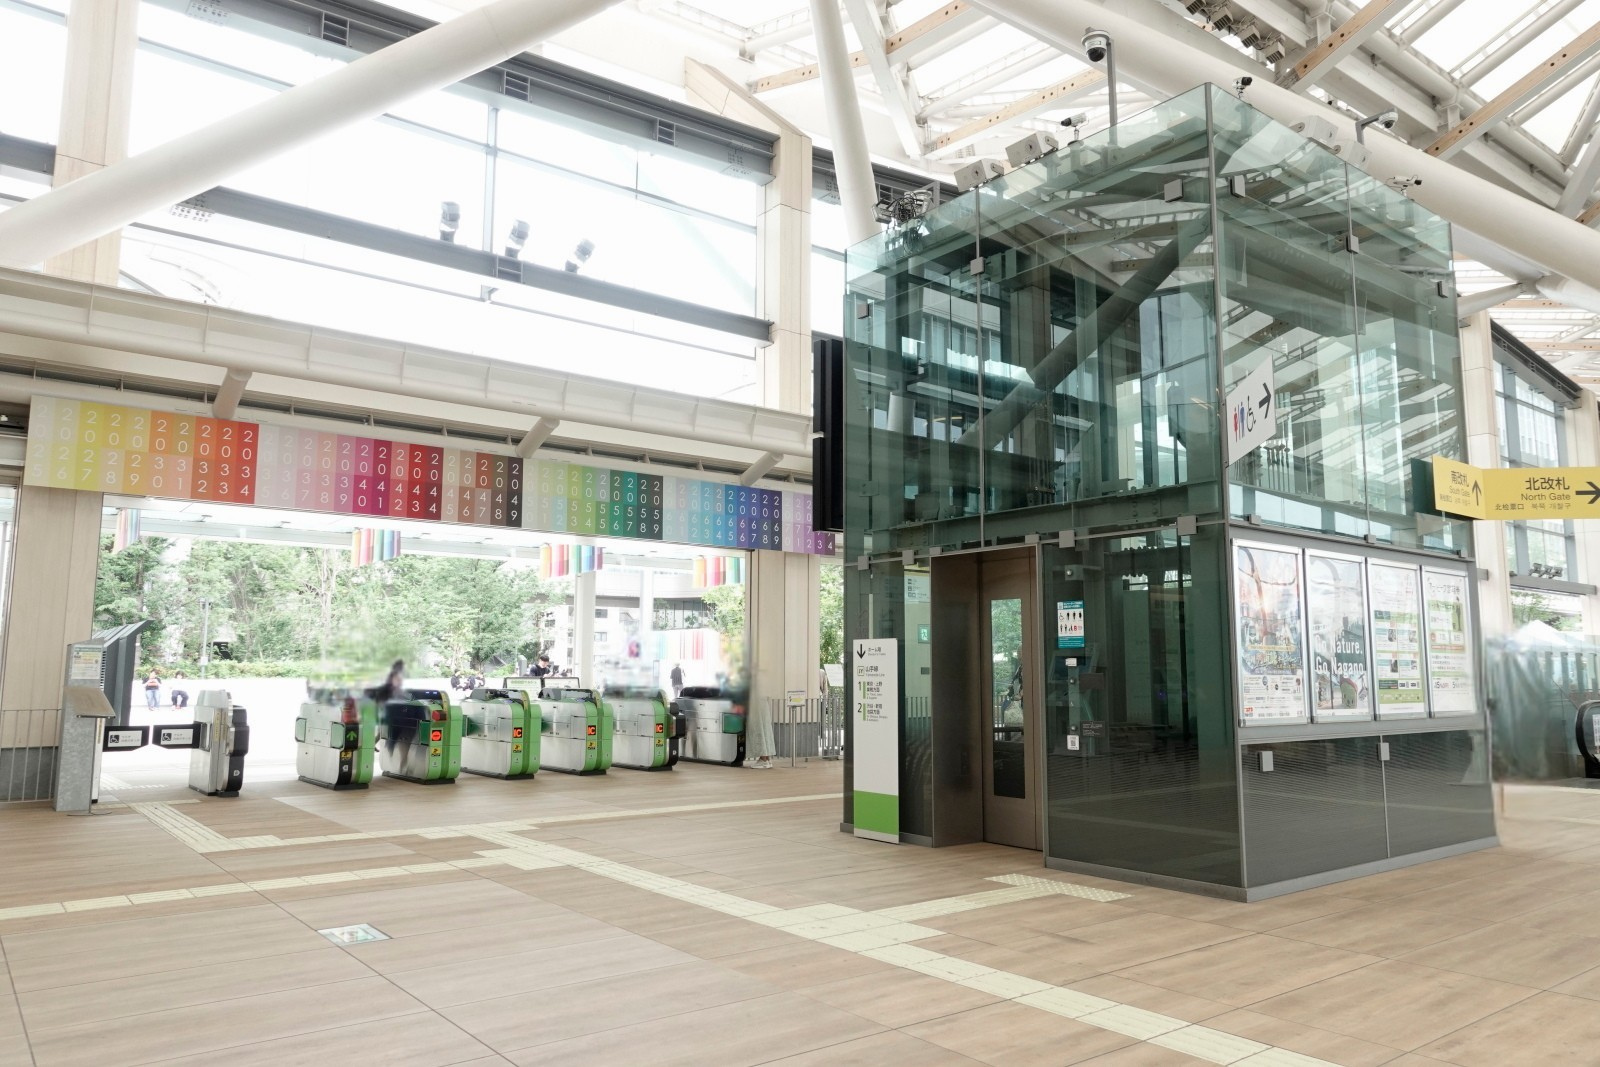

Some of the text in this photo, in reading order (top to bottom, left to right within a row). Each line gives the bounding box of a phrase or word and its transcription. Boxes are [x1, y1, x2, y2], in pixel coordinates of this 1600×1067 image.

[1451, 471, 1470, 487] 南改札
[1525, 477, 1570, 491] 北改札
[1521, 493, 1571, 501] North Gate
[1316, 656, 1328, 675] Go
[857, 702, 862, 713] 2
[513, 728, 522, 738] IC
